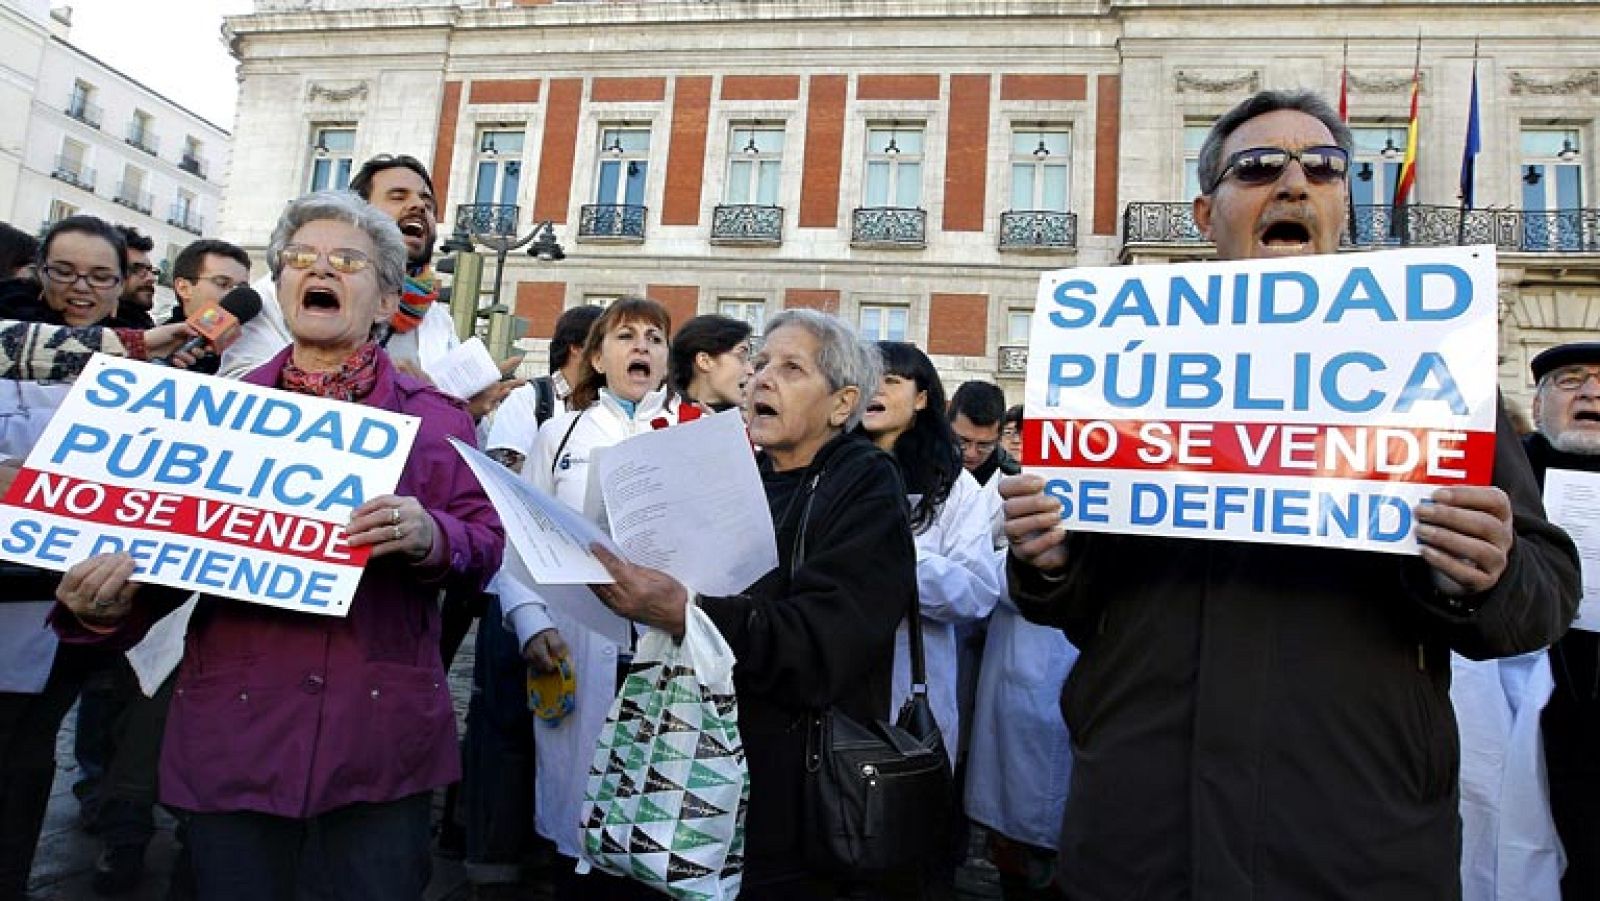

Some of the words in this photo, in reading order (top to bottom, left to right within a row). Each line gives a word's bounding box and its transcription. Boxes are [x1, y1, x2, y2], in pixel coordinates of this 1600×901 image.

[1048, 263, 1474, 329] SANIDAD
[85, 368, 399, 460] SANIDAD
[1045, 339, 1470, 416] PÚBLICA
[50, 422, 365, 512] PÚBLICA
[1040, 420, 1118, 461] NO
[1136, 421, 1214, 466] SE
[1234, 424, 1468, 479] VENDE
[24, 471, 110, 515] NO
[116, 490, 184, 528] SE
[194, 502, 352, 561] VENDE
[1043, 479, 1110, 524] SE
[1130, 483, 1437, 545] DEFIEND
[1, 518, 80, 563] SE
[89, 533, 339, 608] DEFIENDE
